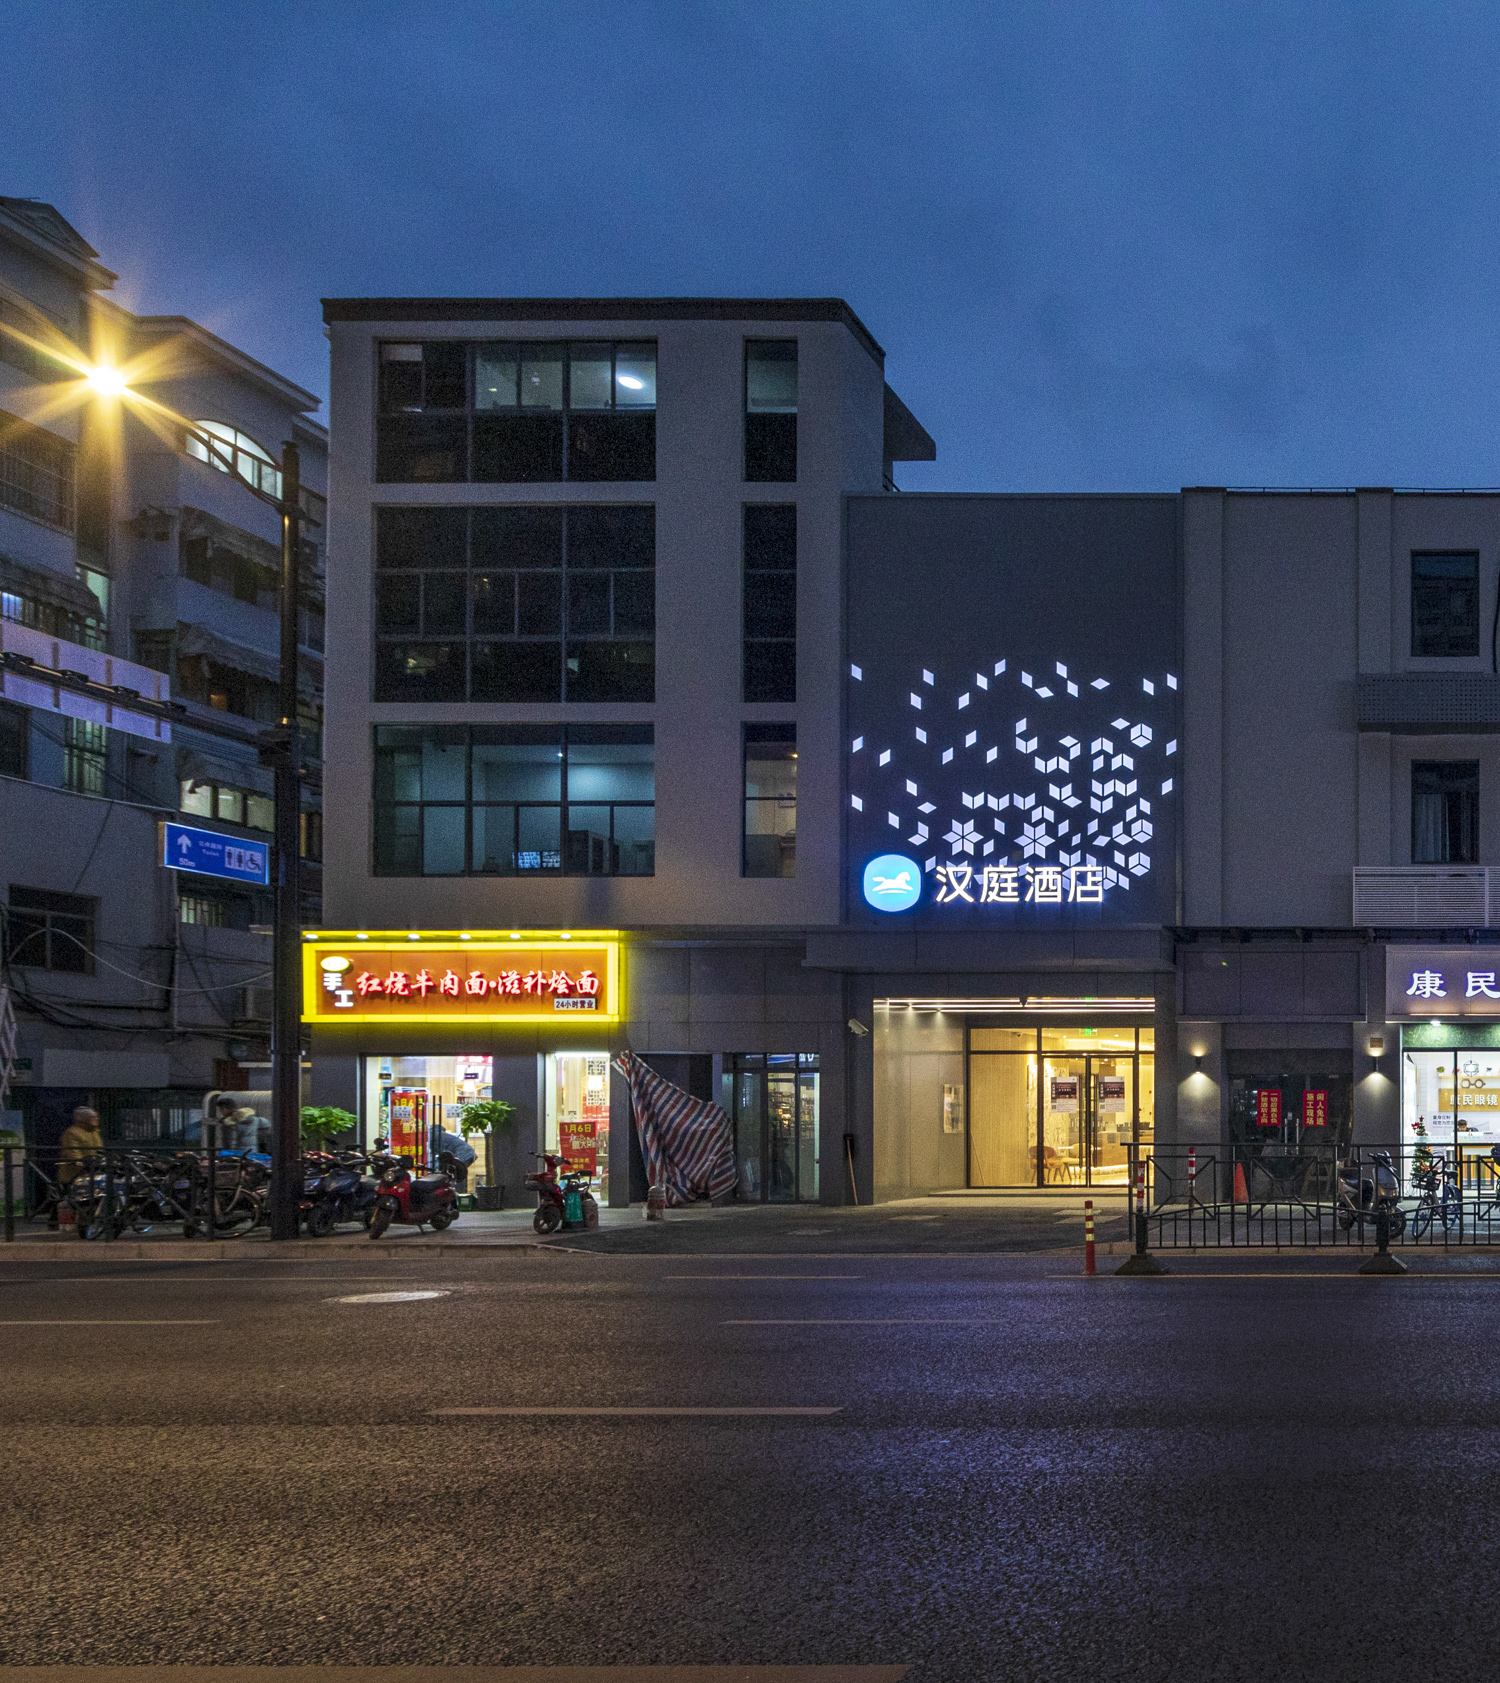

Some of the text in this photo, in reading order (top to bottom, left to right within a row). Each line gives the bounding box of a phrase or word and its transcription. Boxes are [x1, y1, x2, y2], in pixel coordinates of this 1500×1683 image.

[179, 858, 196, 867] 50m
[934, 864, 1104, 904] 汉庭酒店
[323, 972, 354, 1008] 手工
[555, 999, 594, 1009] 24小时营业
[1306, 1093, 1314, 1125] 施工现场
[1316, 1093, 1325, 1125] 闲人免进
[1449, 1094, 1499, 1106] 康民眼镜
[565, 1124, 591, 1133] 1月6日
